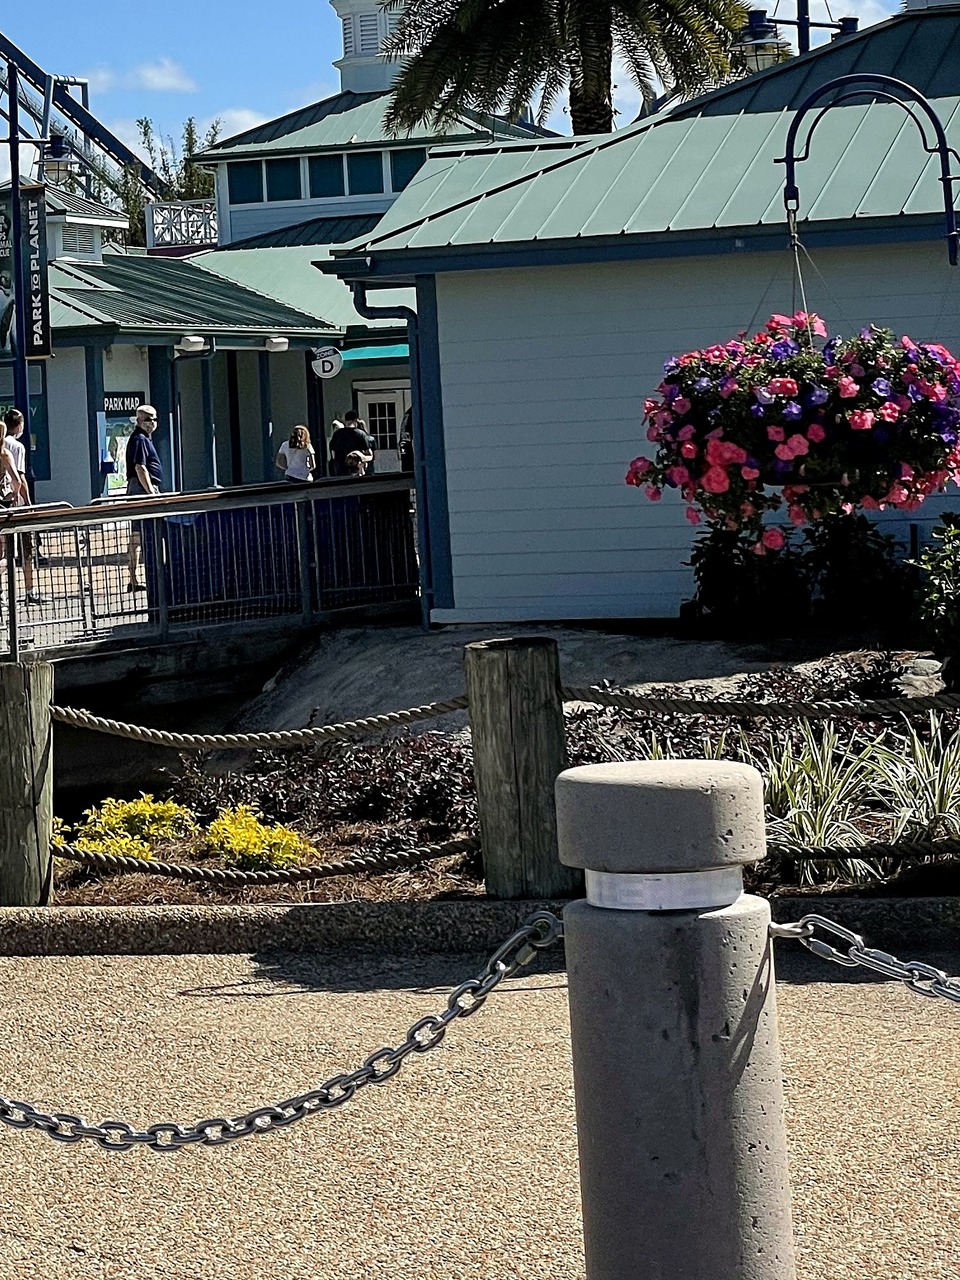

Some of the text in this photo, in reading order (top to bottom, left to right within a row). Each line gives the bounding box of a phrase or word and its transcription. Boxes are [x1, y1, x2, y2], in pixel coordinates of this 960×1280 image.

[28, 200, 43, 346] PARK TO PLANET
[316, 350, 335, 360] ZONE
[322, 360, 334, 373] D
[104, 397, 140, 411] PARK MAP
